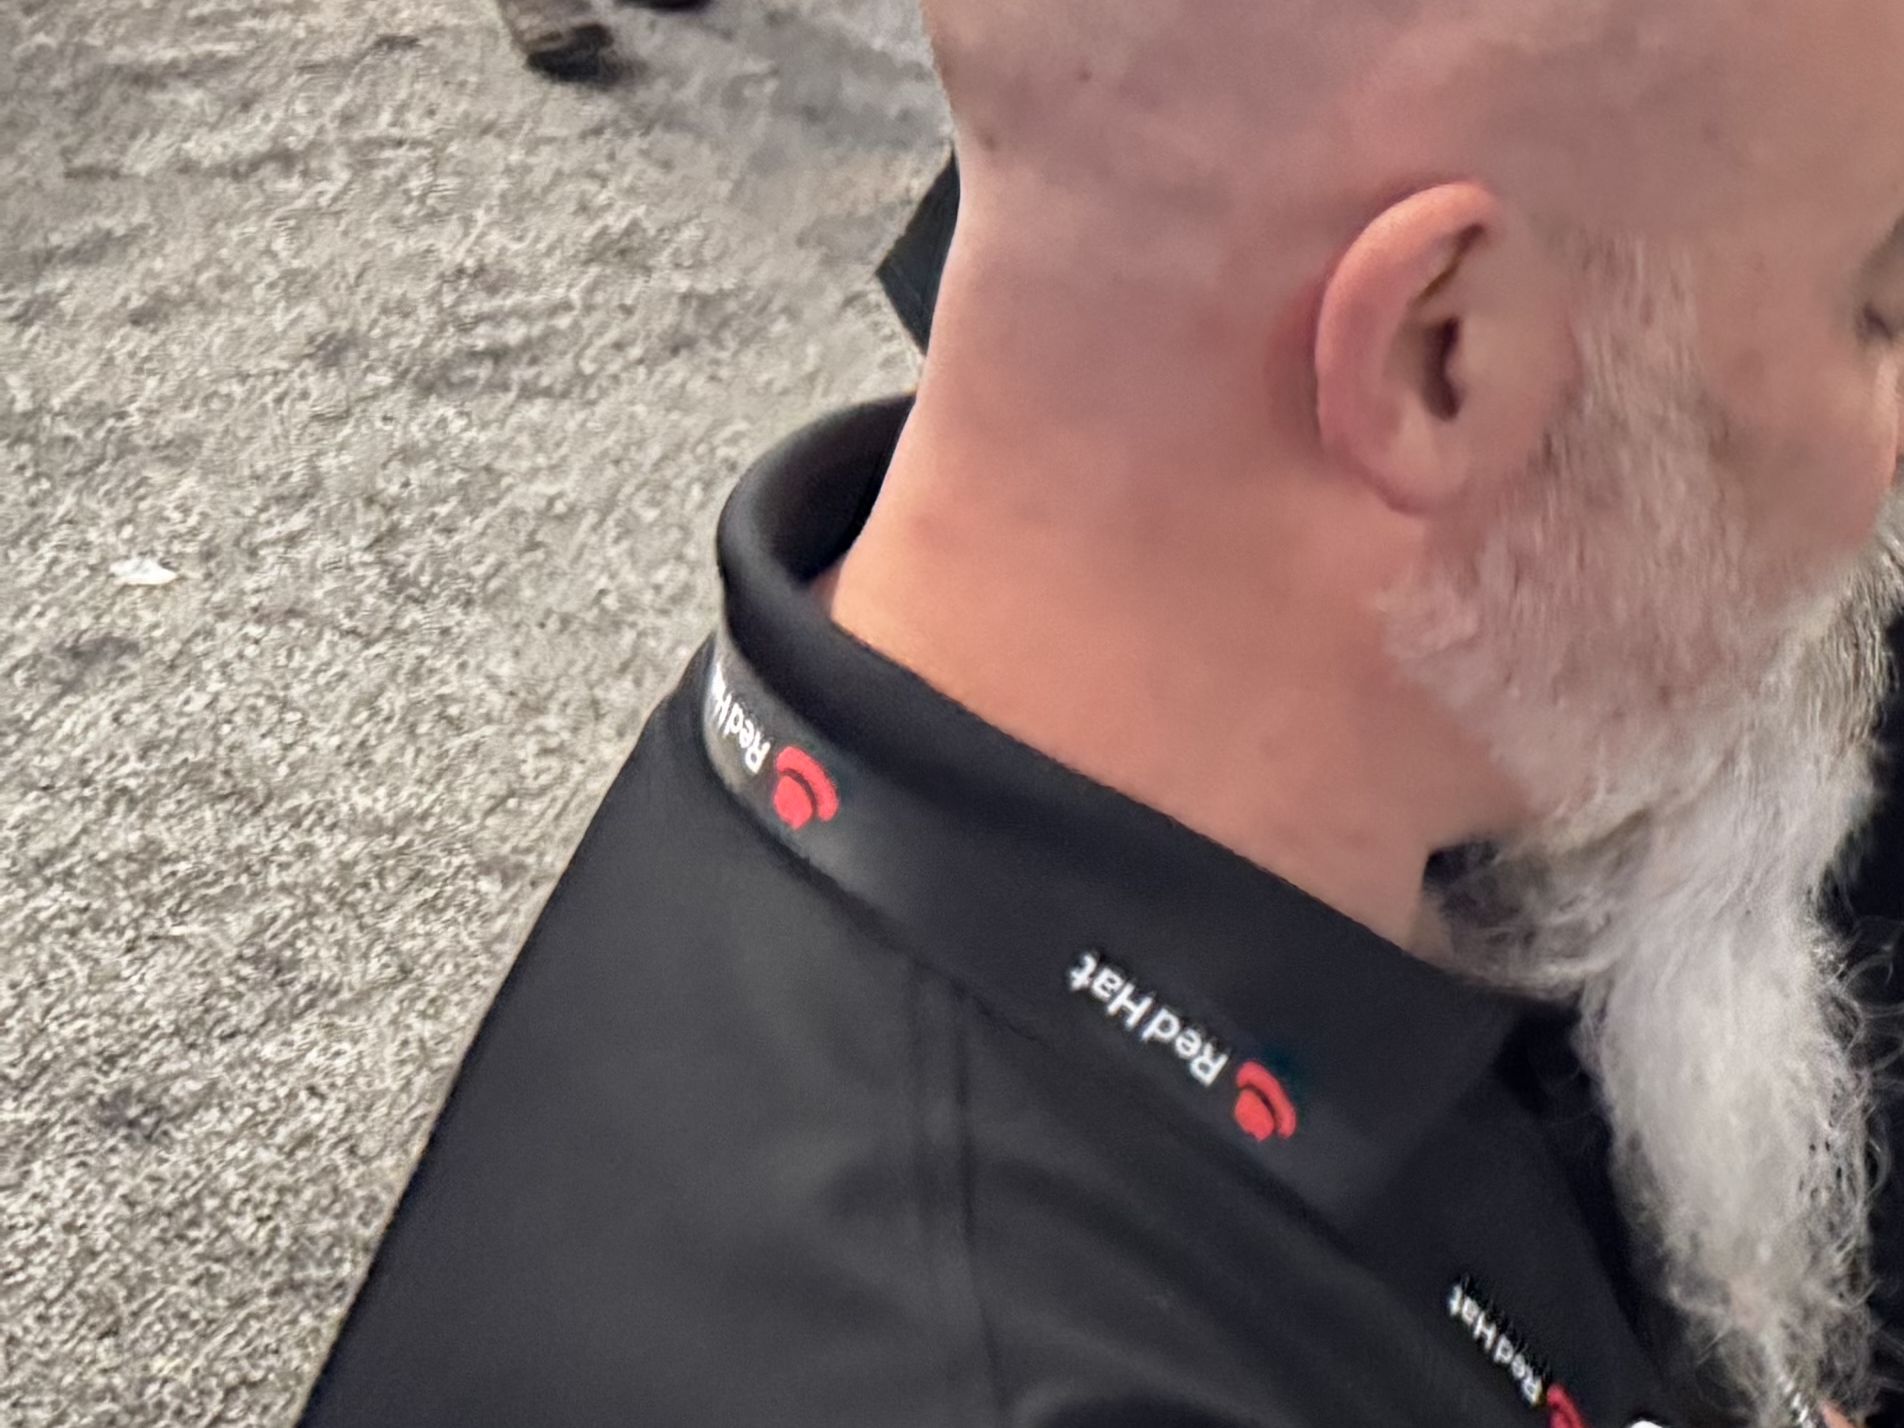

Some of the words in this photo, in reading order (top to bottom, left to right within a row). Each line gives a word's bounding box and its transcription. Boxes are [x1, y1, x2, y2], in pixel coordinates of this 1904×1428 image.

[721, 701, 771, 775] Red
[1066, 949, 1157, 1032] Hat
[1138, 1004, 1227, 1086] Red
[1448, 1284, 1497, 1351] Hat
[1493, 1333, 1543, 1407] Red
